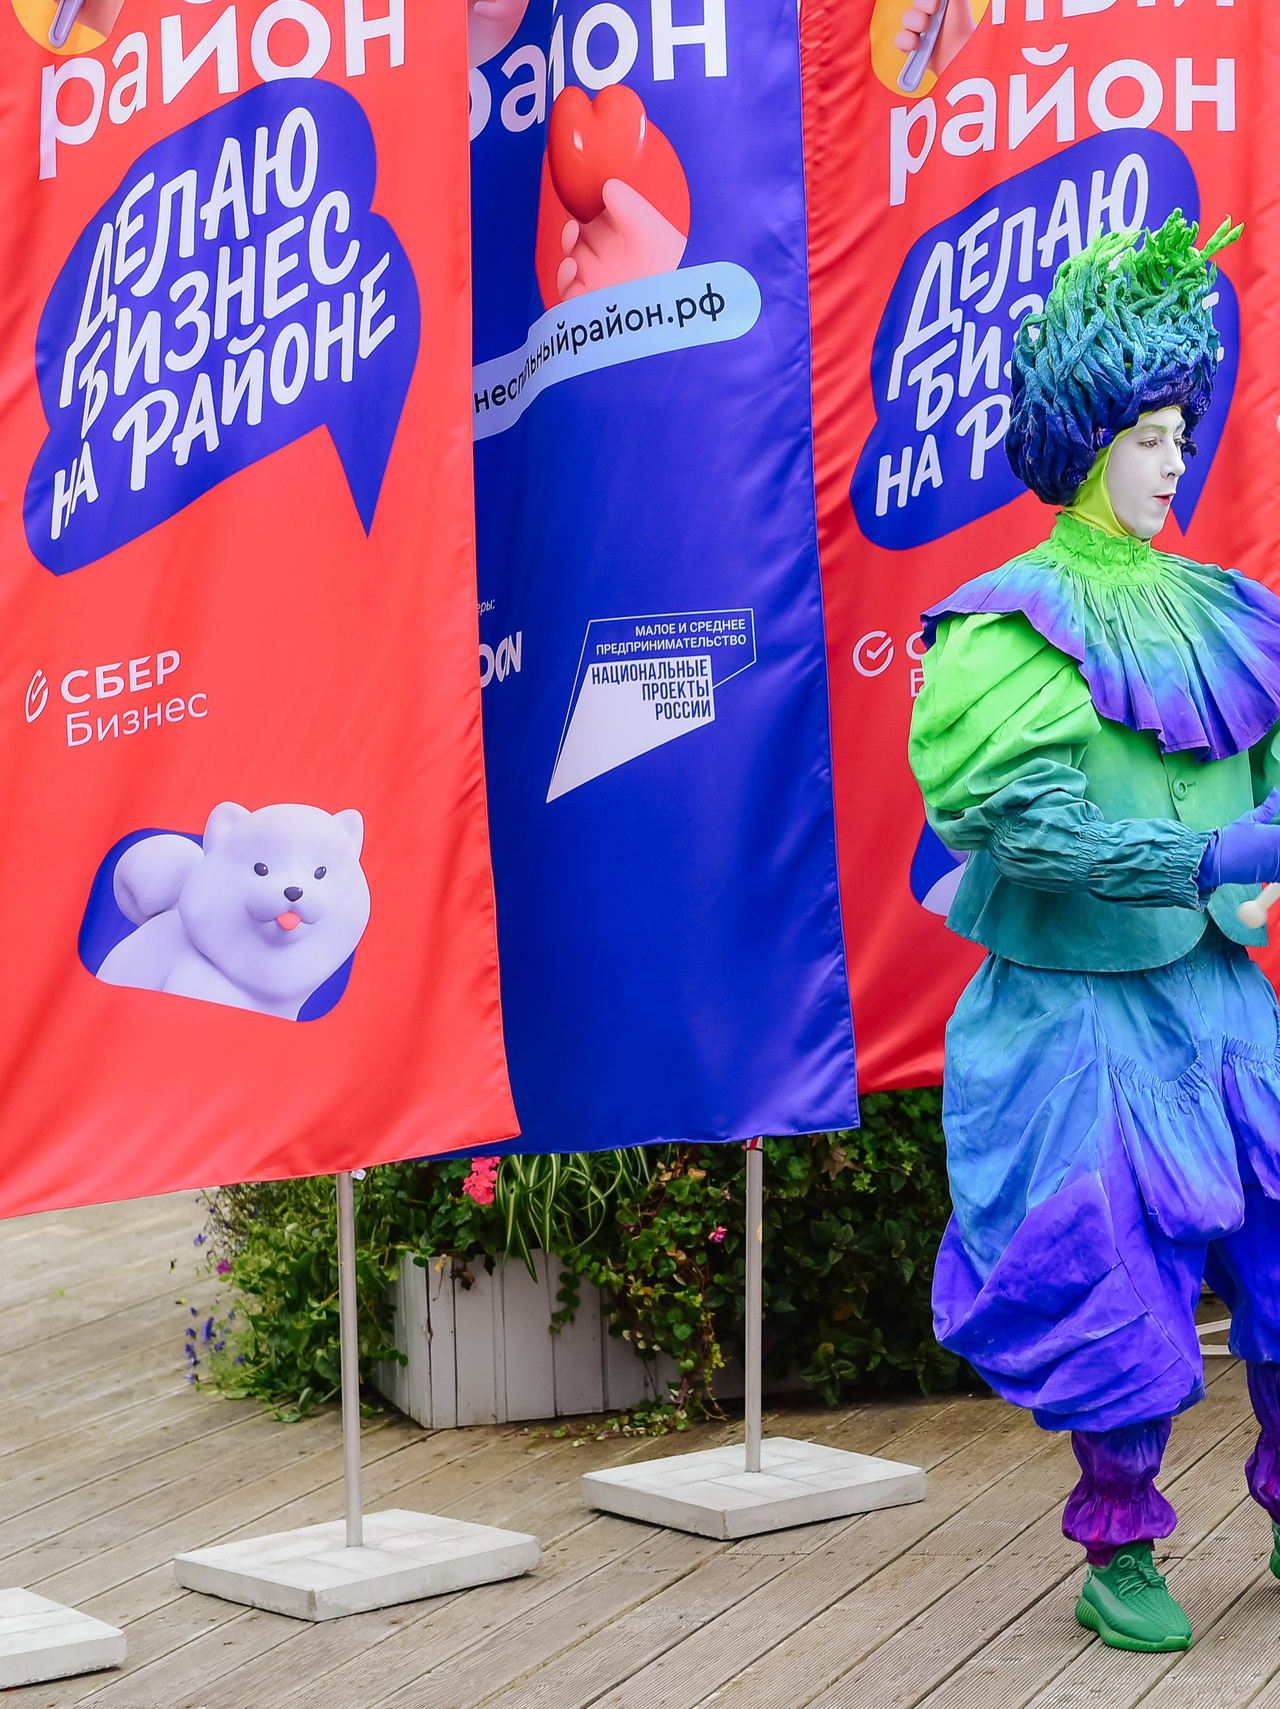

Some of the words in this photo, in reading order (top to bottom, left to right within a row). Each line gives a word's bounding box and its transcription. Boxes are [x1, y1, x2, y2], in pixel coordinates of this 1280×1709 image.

[889, 43, 1237, 206] район
[59, 107, 318, 408] ДЕЛАЮ
[887, 153, 1149, 401] ДЕЛАЮ
[80, 191, 361, 439] БИЗНЕС
[50, 442, 99, 540] НА
[112, 252, 397, 491] РАЙОНЕ
[875, 433, 943, 517] НА
[596, 634, 747, 656] ПРЕДПРИНИМАТЕЛЬСТВО
[635, 623, 676, 637] МАЛОЕ
[678, 623, 687, 634] И
[689, 618, 746, 633] СРЕДНЕЕ
[60, 650, 181, 705] СБЕР
[591, 659, 709, 685] НАЦИОНАЛЬНЫЕ
[642, 680, 710, 701] ПРОЕКТЫ
[66, 692, 209, 747] Бизнес
[655, 700, 711, 721] РОССИИ
